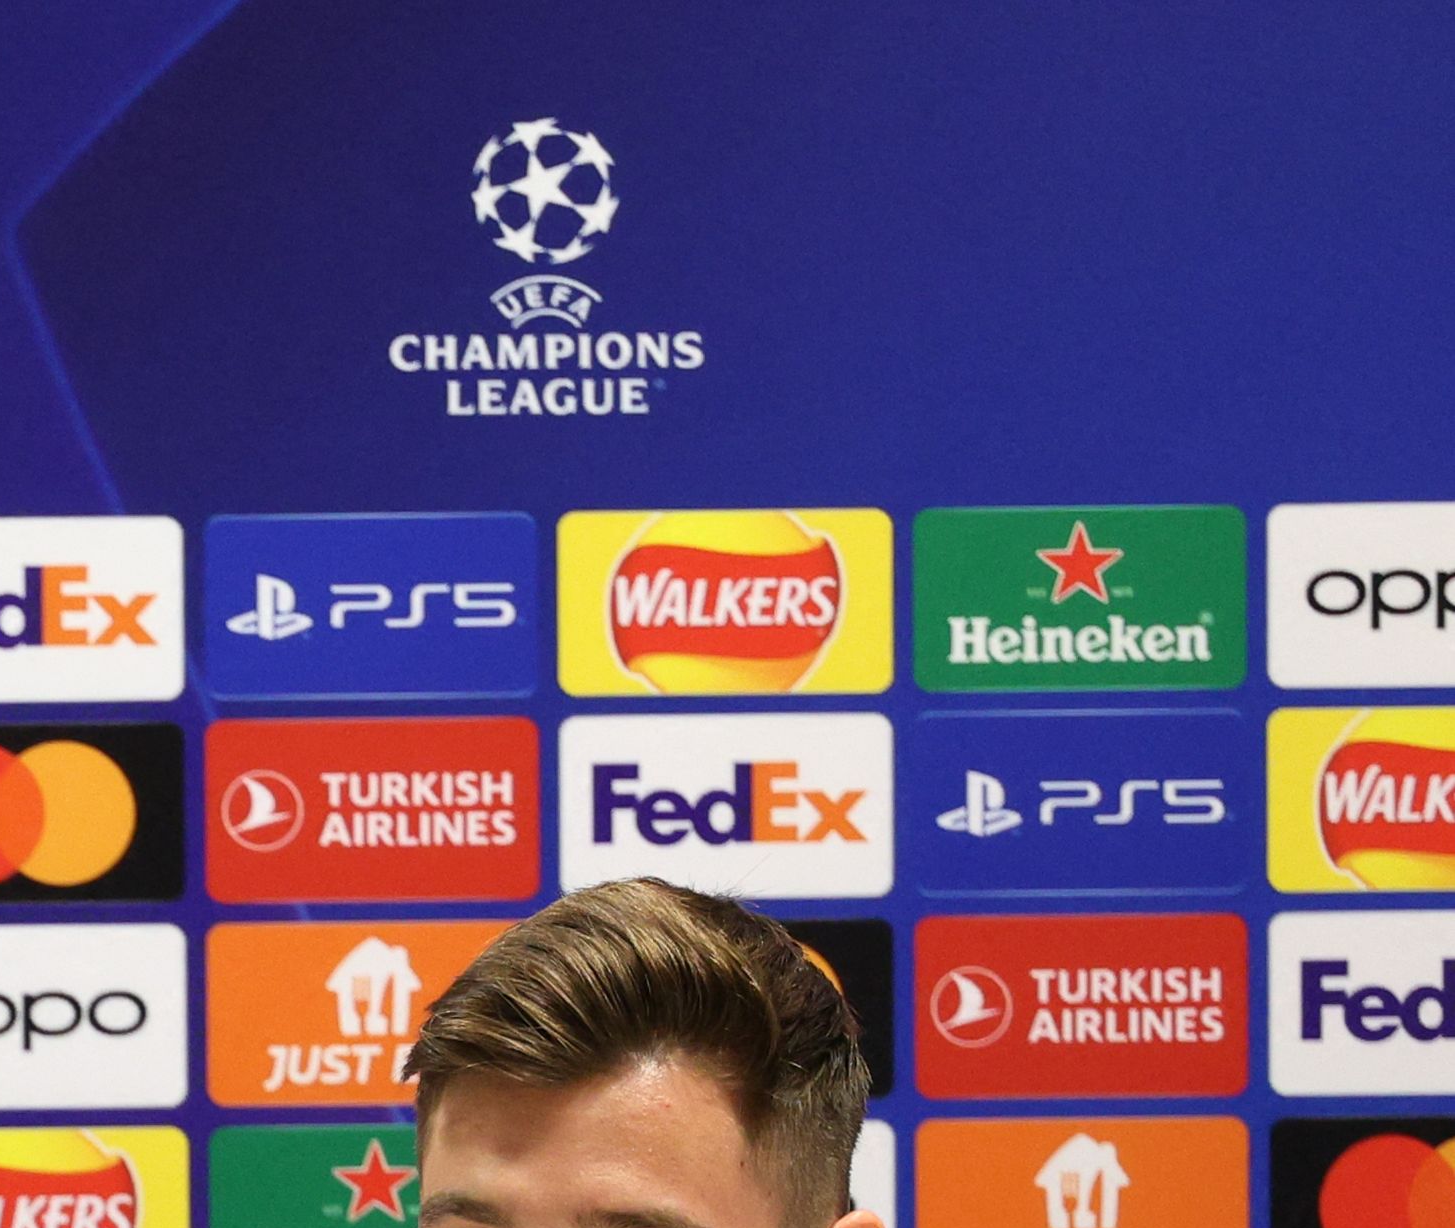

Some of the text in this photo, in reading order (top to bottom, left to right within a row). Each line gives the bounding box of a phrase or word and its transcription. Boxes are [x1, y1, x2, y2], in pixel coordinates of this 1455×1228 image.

[495, 284, 595, 321] UEFA
[389, 331, 704, 372] CHAMPIONS
[447, 378, 649, 416] LEAGUE
[329, 582, 516, 629] PS5
[614, 567, 837, 627] WALKERS
[1305, 569, 1455, 631] op
[948, 615, 1212, 664] Heineken
[321, 771, 514, 808] TURKISH
[592, 761, 867, 847] FedEx
[1039, 779, 1225, 825] PS5
[1324, 763, 1455, 824] WALK
[319, 810, 517, 847] AIRLINES
[1030, 967, 1222, 1004] TURKISH
[1300, 958, 1455, 1043] Fed
[1028, 1006, 1224, 1043] AIRLINES
[264, 1043, 383, 1092] JUST
